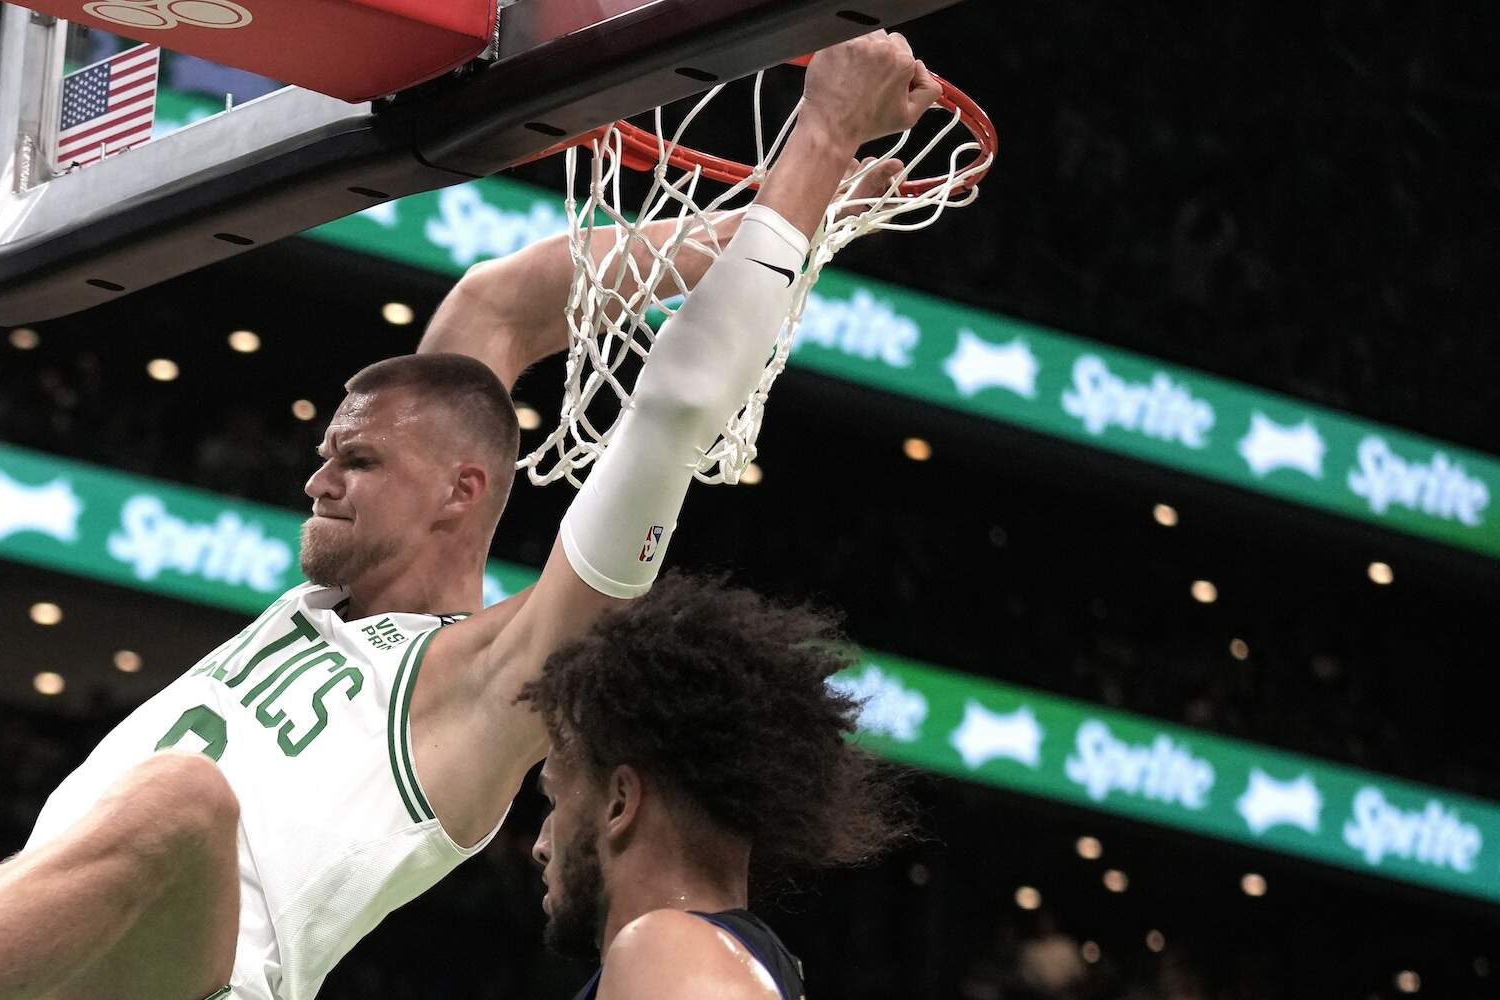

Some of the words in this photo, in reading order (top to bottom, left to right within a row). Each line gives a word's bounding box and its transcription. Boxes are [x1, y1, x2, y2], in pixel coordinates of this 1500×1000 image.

[789, 288, 920, 367] prite
[1061, 355, 1215, 449] Sprite
[1348, 436, 1489, 525] Sprite
[107, 495, 291, 592] Sprite
[375, 617, 407, 645] VIS
[1065, 720, 1214, 809] Sprite
[1343, 787, 1482, 872] Sprite
